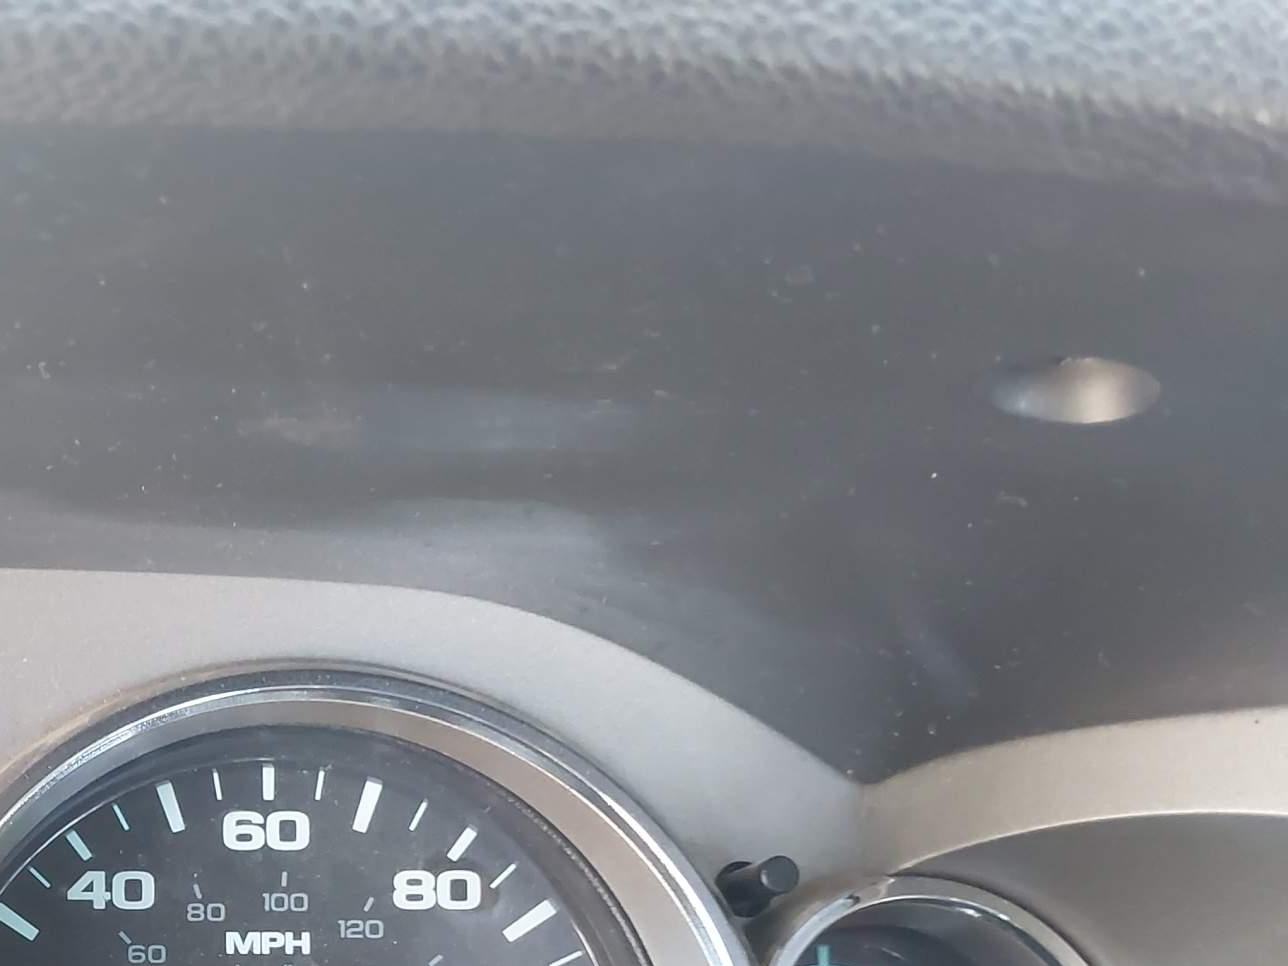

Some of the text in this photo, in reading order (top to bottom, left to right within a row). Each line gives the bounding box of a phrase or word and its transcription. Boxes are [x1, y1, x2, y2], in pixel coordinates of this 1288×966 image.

[222, 810, 310, 851] 60
[66, 870, 155, 910] 40
[392, 870, 481, 911] 80
[186, 903, 226, 922] 80
[262, 893, 308, 912] 100
[338, 920, 384, 939] 120
[225, 932, 310, 954] MPH
[127, 945, 167, 964] 60
